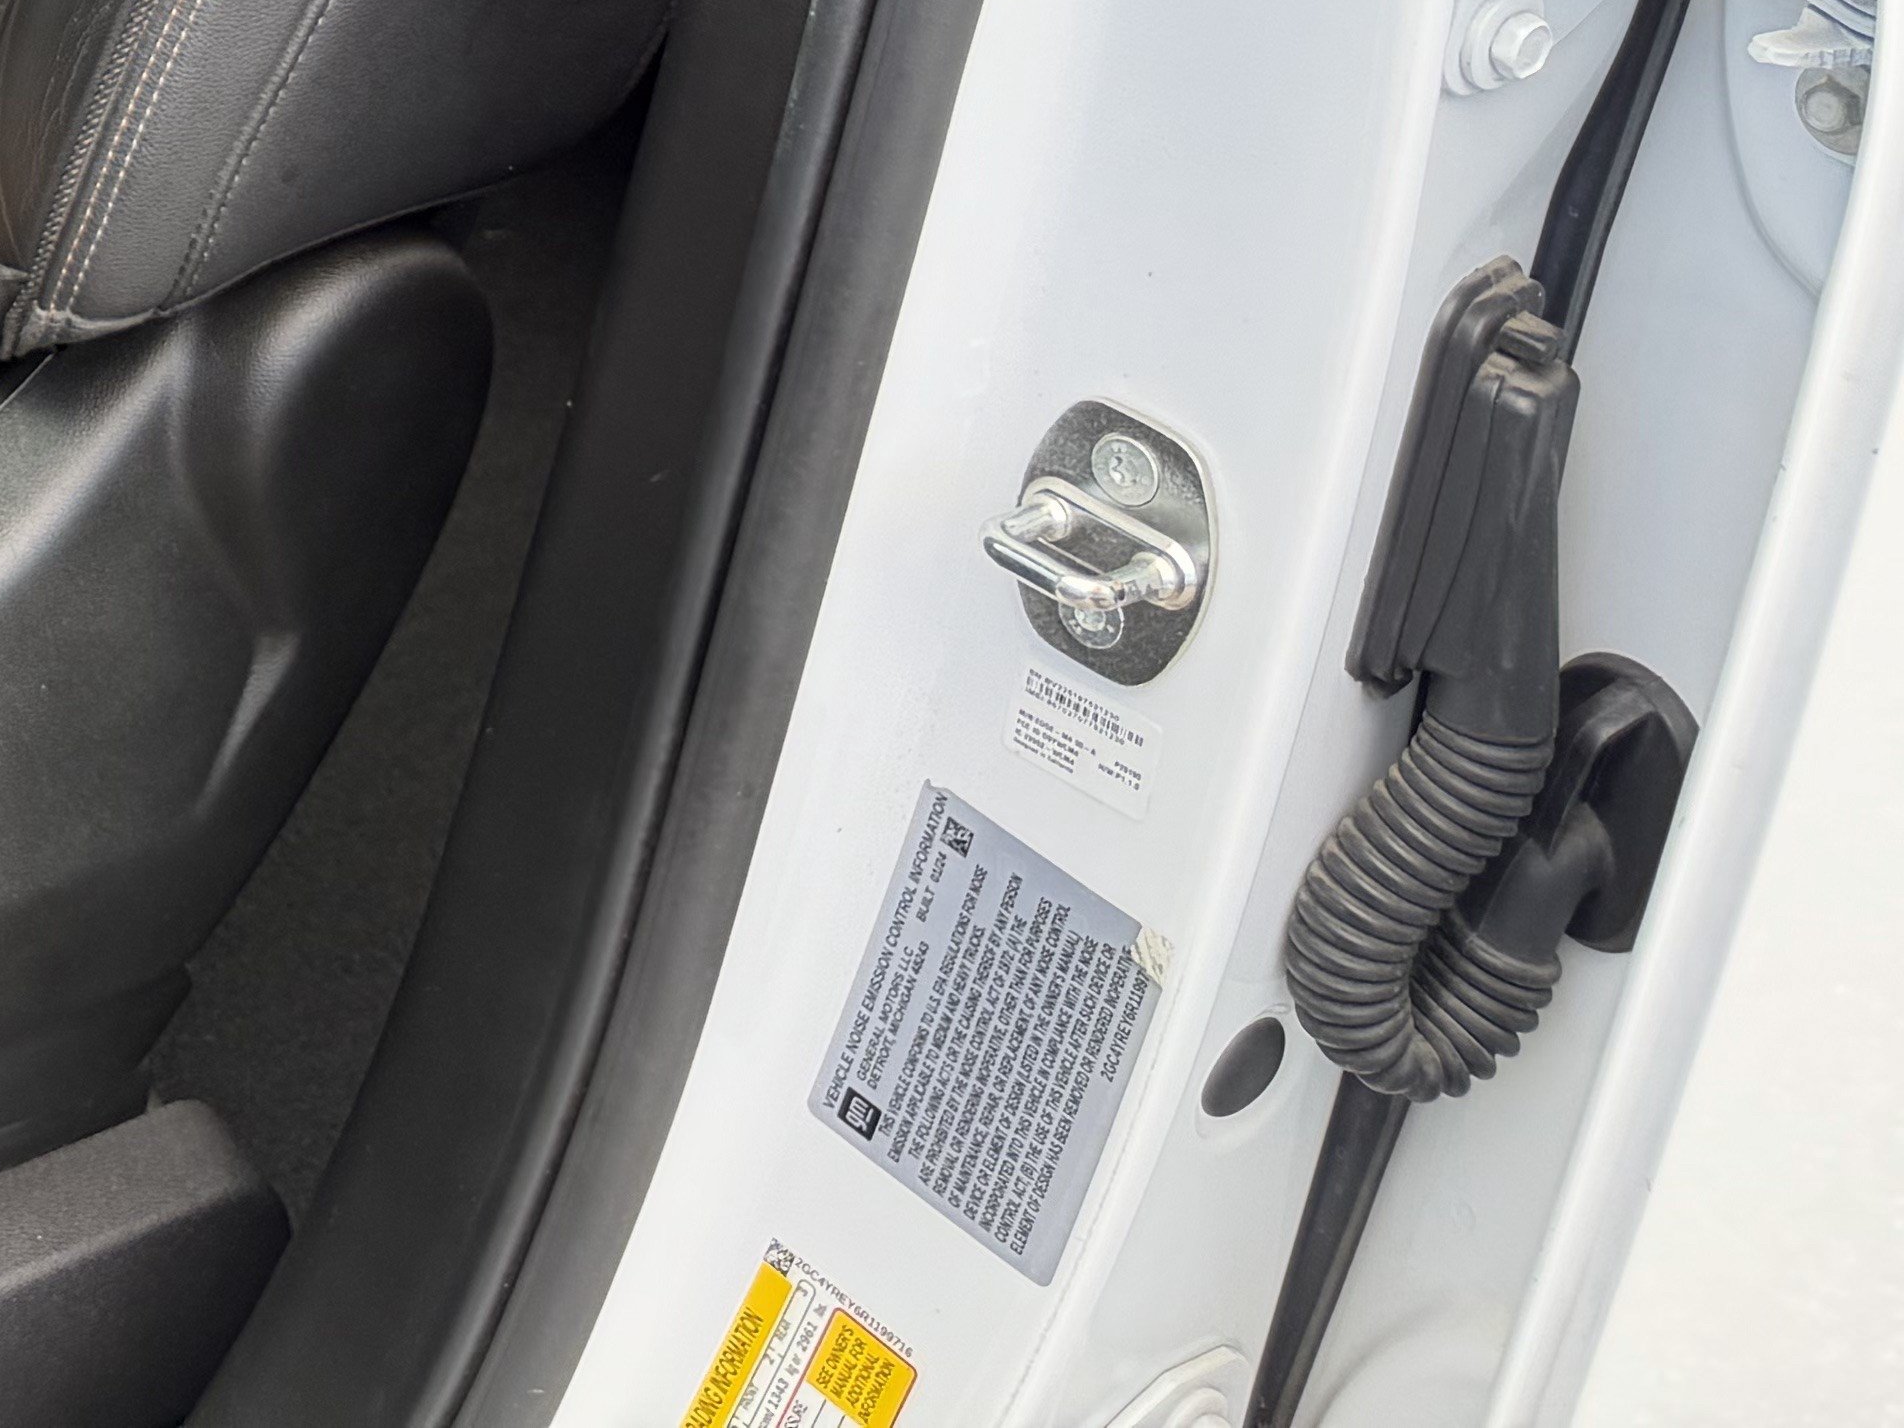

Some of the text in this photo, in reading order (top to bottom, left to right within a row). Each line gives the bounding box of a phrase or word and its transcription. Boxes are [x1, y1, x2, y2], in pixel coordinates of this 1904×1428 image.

[968, 864, 987, 895] NOISE
[915, 885, 936, 923] BUILT
[961, 891, 977, 915] FOR
[939, 911, 970, 978] REGULATIONS
[1005, 932, 1023, 954] (A)
[1010, 913, 1027, 937] THE
[822, 790, 949, 1112] VEHICLE NOISE EMISSION CONTROL INFORMATION
[932, 974, 948, 996] EPA
[951, 962, 971, 995] HEAVY
[984, 984, 1001, 1009] ACT
[991, 970, 1006, 989] OF
[855, 944, 914, 1083] GENERAL MOTORS LLC
[907, 871, 1023, 1161] THE FOLLOWING ACTS OR THE CAUSING THEREOF BY ANY PERSON
[920, 1010, 934, 1028] TO
[943, 991, 961, 1016] AND
[866, 1033, 896, 1092] DETROIT,
[887, 973, 916, 1036] MICHIGAN
[930, 1011, 953, 1051] MEDIUM
[932, 895, 1052, 1198] REMOVAL OR RENDERING INOPERATIVE, OTHER THAN FOR PURPOSES
[968, 1003, 994, 1052] CONTROL
[1085, 1004, 1113, 1059] RENDERED
[901, 1024, 929, 1080] CONFORMS
[925, 1047, 939, 1064] TO
[947, 900, 1070, 1209] OF MAINTENANCE, REPAIR, OR REPLACEMENT, OF ANY NOISE CONTROL
[958, 1047, 978, 1080] NOISE
[1079, 1054, 1095, 1074] OR
[886, 1074, 910, 1117] VEHICLE
[904, 1060, 934, 1120] APPLICABLE
[951, 1075, 967, 1099] THE
[963, 928, 1083, 1221] DEVICE OR ELEMENT OF DESIGN (LISTED IN THE OWNER'S MANUAL)
[977, 934, 1098, 1234] INCORPORATED INTO THIS VEHICLE IN COMPLIANCE WITH THE NOISE
[993, 941, 1116, 1245] CONTROL ACT, (B) THE USE OF THIS VEHICLE AFTER SUCH DEVICE OR
[1062, 1068, 1090, 1119] REMOVED
[844, 1094, 873, 1133] gm
[878, 1112, 895, 1138] THIS
[945, 1094, 960, 1113] BY
[887, 1114, 913, 1163] EMISSION
[925, 1107, 955, 1166] PROHIBITED
[1052, 1115, 1072, 1145] BEEN
[917, 1161, 934, 1186] ARE
[1045, 1139, 1063, 1165] HAS
[1032, 1159, 1055, 1200] DESIGN
[1026, 1193, 1042, 1214] OF
[1009, 1207, 1036, 1256] ELEMENT
[708, 1306, 764, 1394] INFORMATION
[767, 1376, 789, 1409] 1343
[796, 1320, 817, 1352] 2961
[815, 1323, 855, 1389] SEE OWNER'S
[829, 1336, 868, 1400] MANUAL FOR
[844, 1350, 880, 1408] ADDITIONAL
[856, 1357, 896, 1424] INFORMATION
